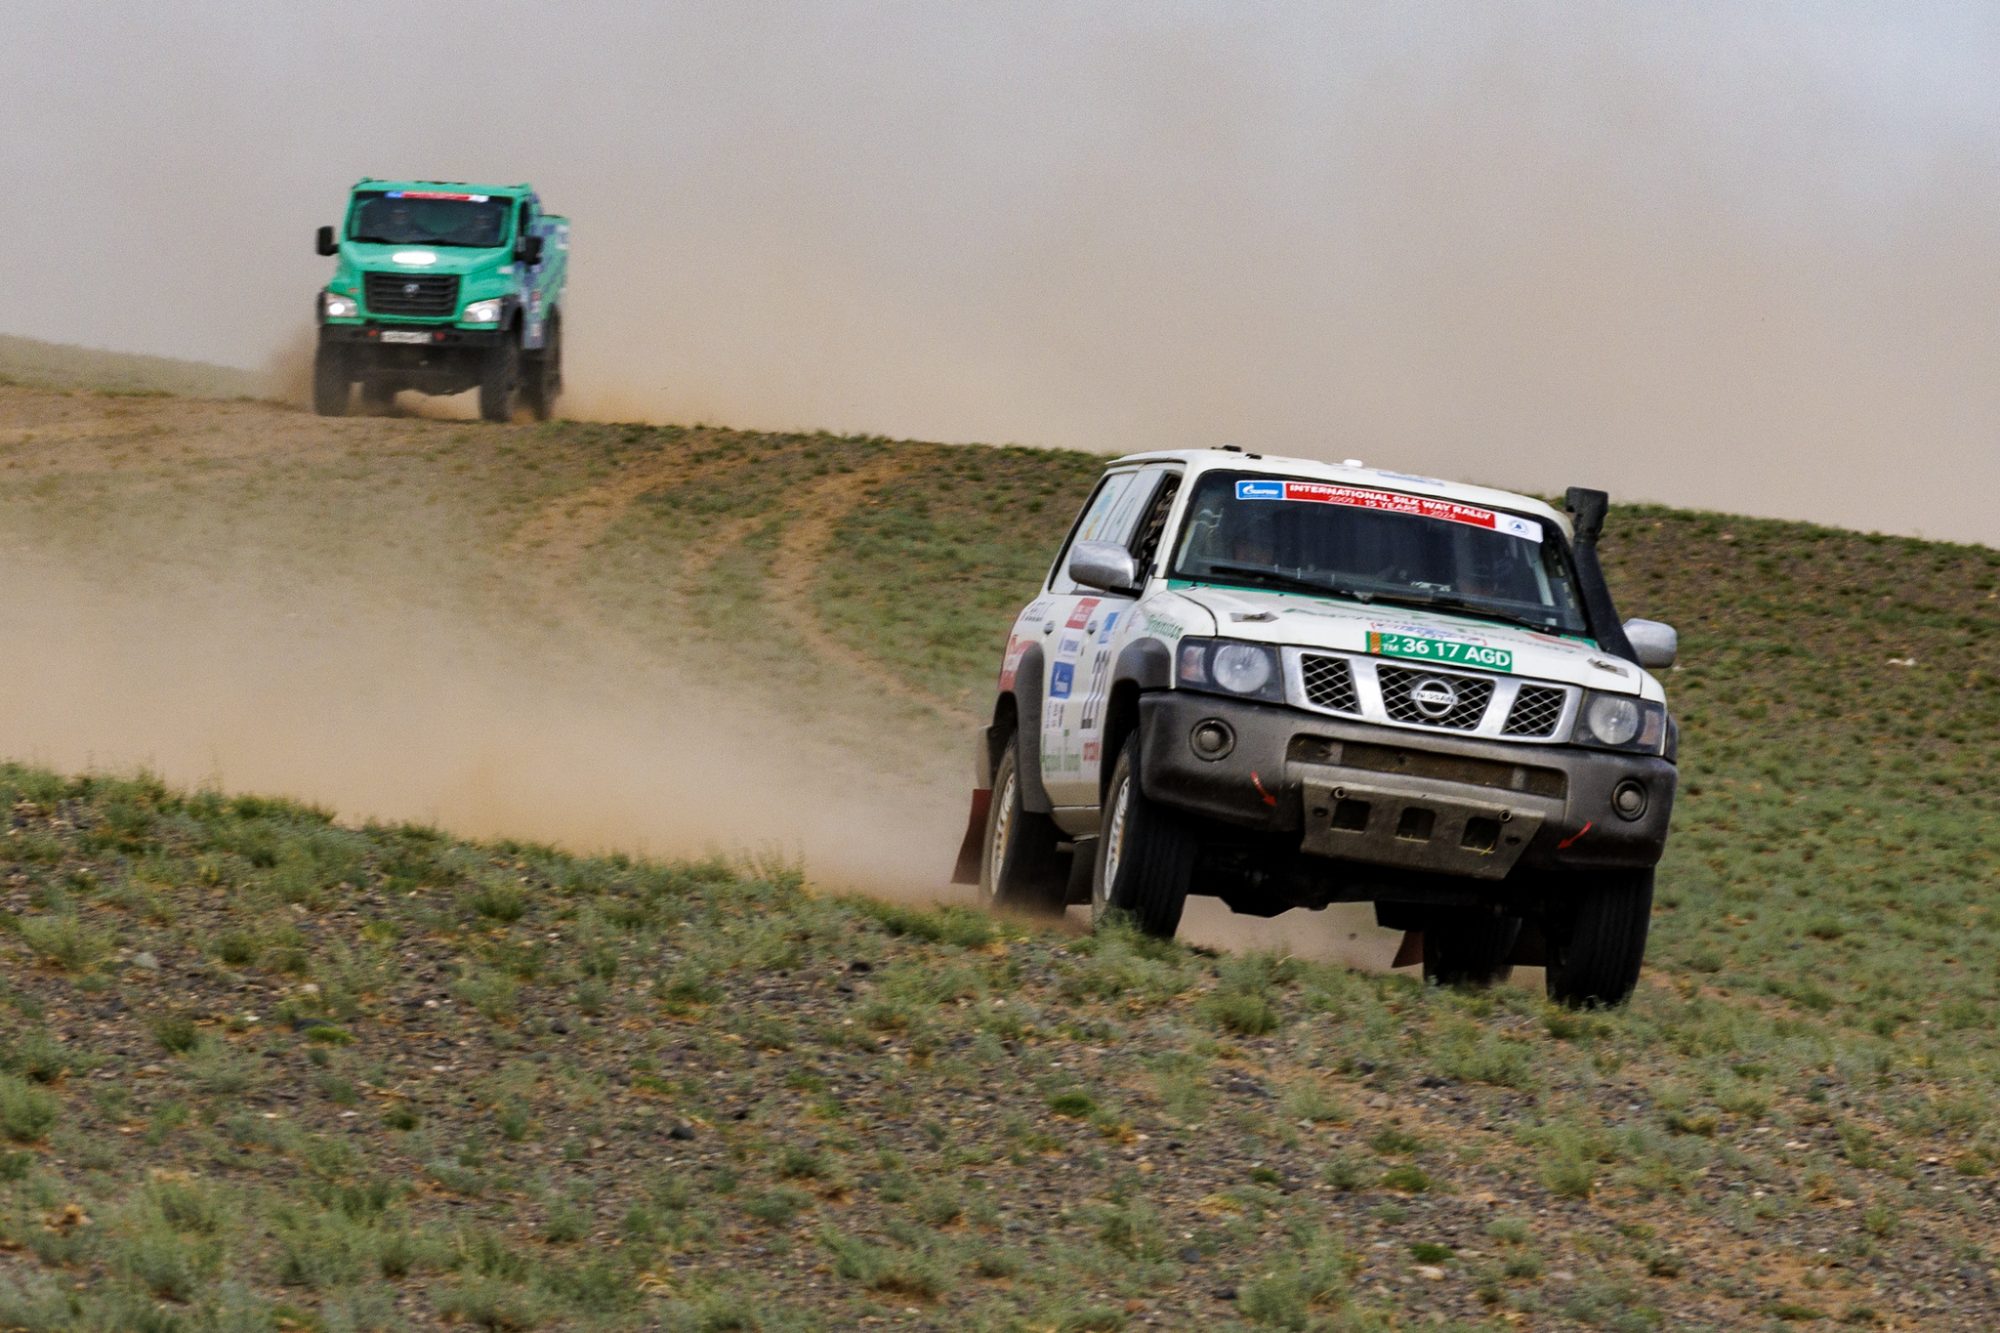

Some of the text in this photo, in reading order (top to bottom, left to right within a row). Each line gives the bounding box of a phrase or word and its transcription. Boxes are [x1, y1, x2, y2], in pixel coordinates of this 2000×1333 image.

[1289, 484, 1391, 501] INTERNATIONAL
[1392, 496, 1420, 506] SILK
[1422, 500, 1451, 512] WAY
[1452, 506, 1491, 520] RALLY
[1364, 499, 1377, 507] 15
[1380, 501, 1420, 513] YEARS
[1403, 638, 1429, 655] 36
[1435, 642, 1460, 658] 17
[1464, 646, 1511, 667] AGD
